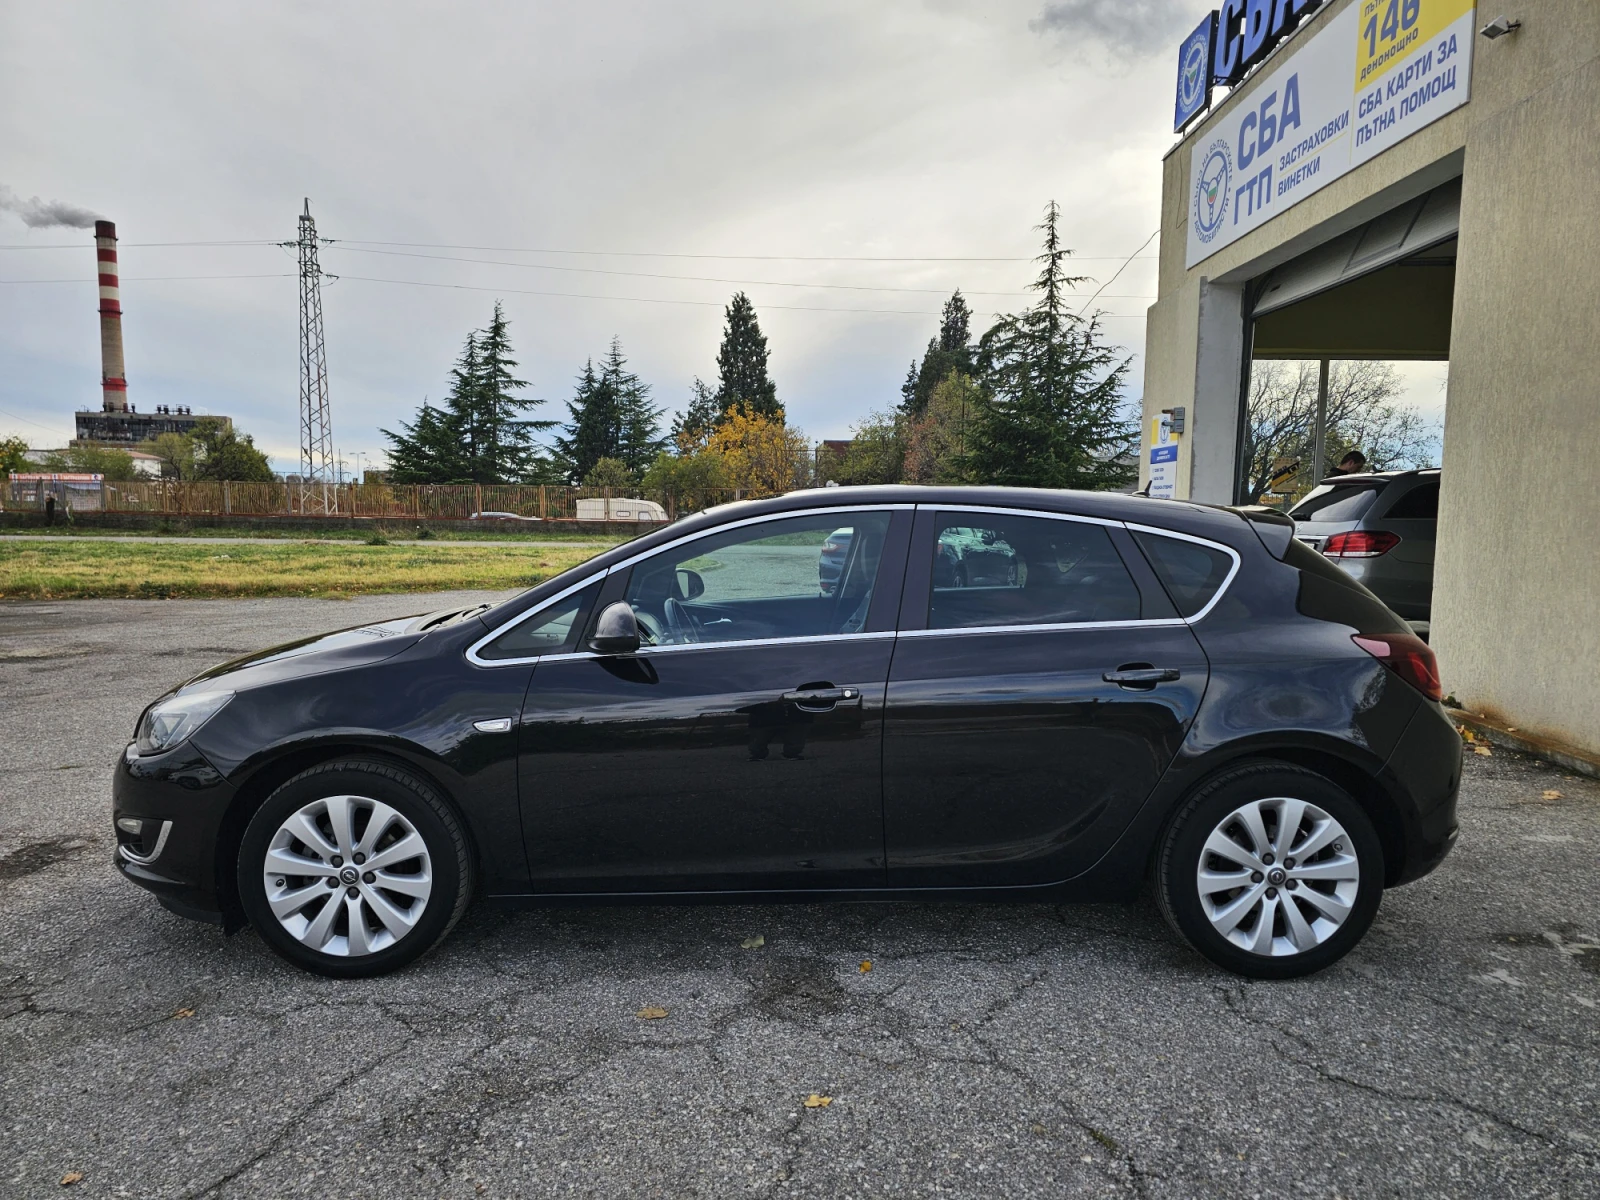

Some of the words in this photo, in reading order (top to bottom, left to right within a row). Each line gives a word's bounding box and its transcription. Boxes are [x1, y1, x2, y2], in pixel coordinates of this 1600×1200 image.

[1360, 27, 1419, 82] денонощно
[1363, 0, 1420, 58] 146
[1356, 106, 1395, 147] ПЪТНА
[1400, 64, 1456, 120] ПОМОЩ
[1358, 87, 1383, 119] СБА
[1386, 50, 1433, 100] КАРТИ
[1437, 33, 1457, 65] ЗА
[1237, 72, 1301, 171] СБА
[1279, 109, 1350, 172] ЗАСТРАХОВКИ
[1234, 164, 1273, 226] ГТП
[1277, 155, 1321, 197] ВИНЕТКИ
